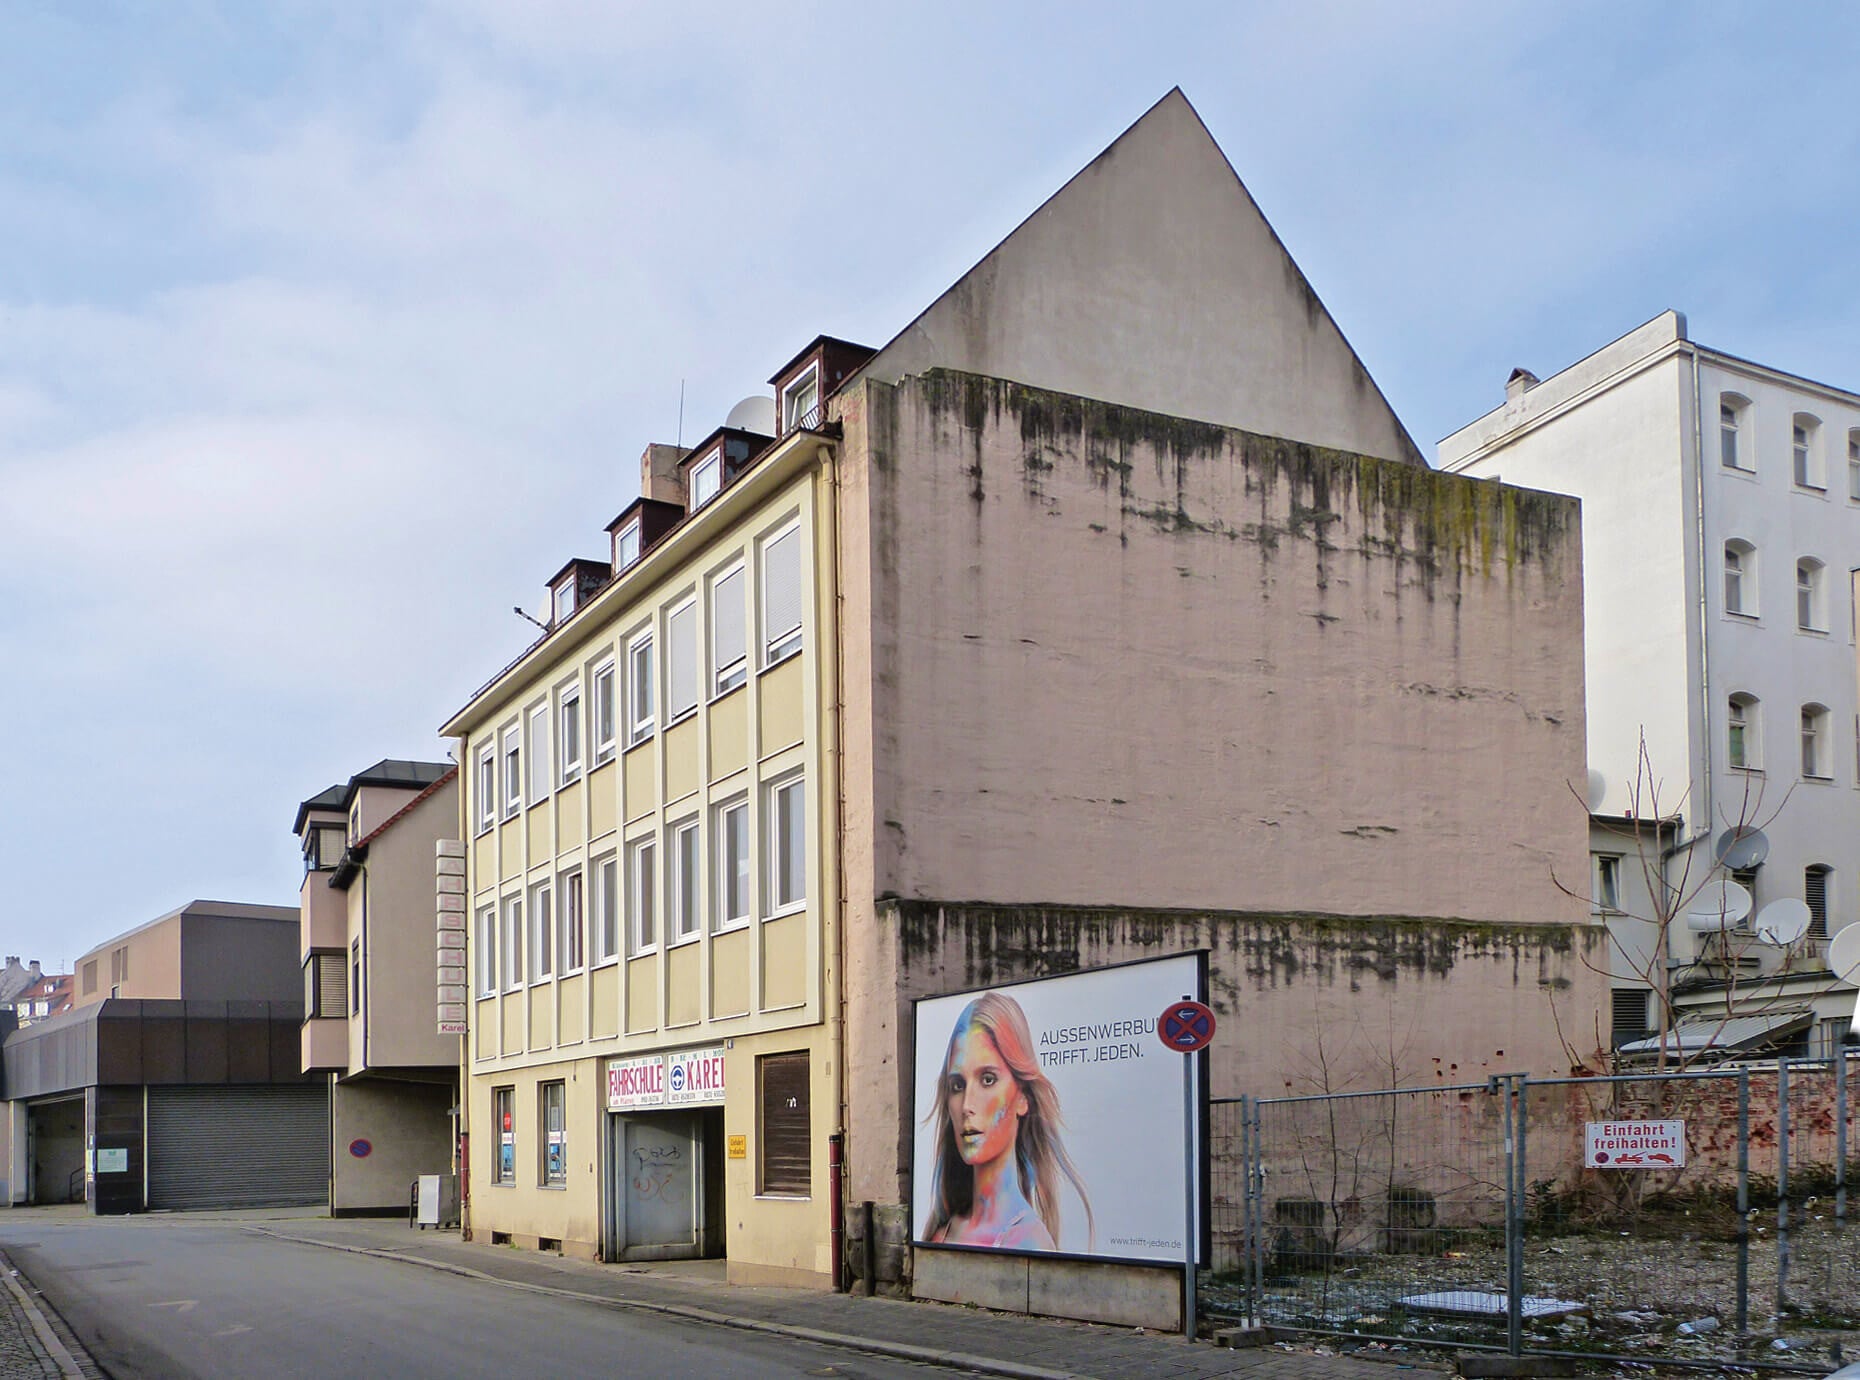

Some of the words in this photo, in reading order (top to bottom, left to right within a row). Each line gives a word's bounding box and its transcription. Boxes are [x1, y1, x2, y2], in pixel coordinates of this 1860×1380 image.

[445, 842, 462, 1019] FAHRSCHULE
[441, 1023, 464, 1033] Karel
[1040, 1017, 1159, 1046] AUSSENWERBU
[1040, 1048, 1090, 1067] TRIFFT.
[1093, 1043, 1144, 1062] JEDEN.
[609, 1064, 663, 1097] FAHRSCHULE
[1604, 1124, 1664, 1136] Einfahrt
[1594, 1137, 1676, 1149] freihalten!
[1110, 1237, 1182, 1249] www.trifft-jeden.de
